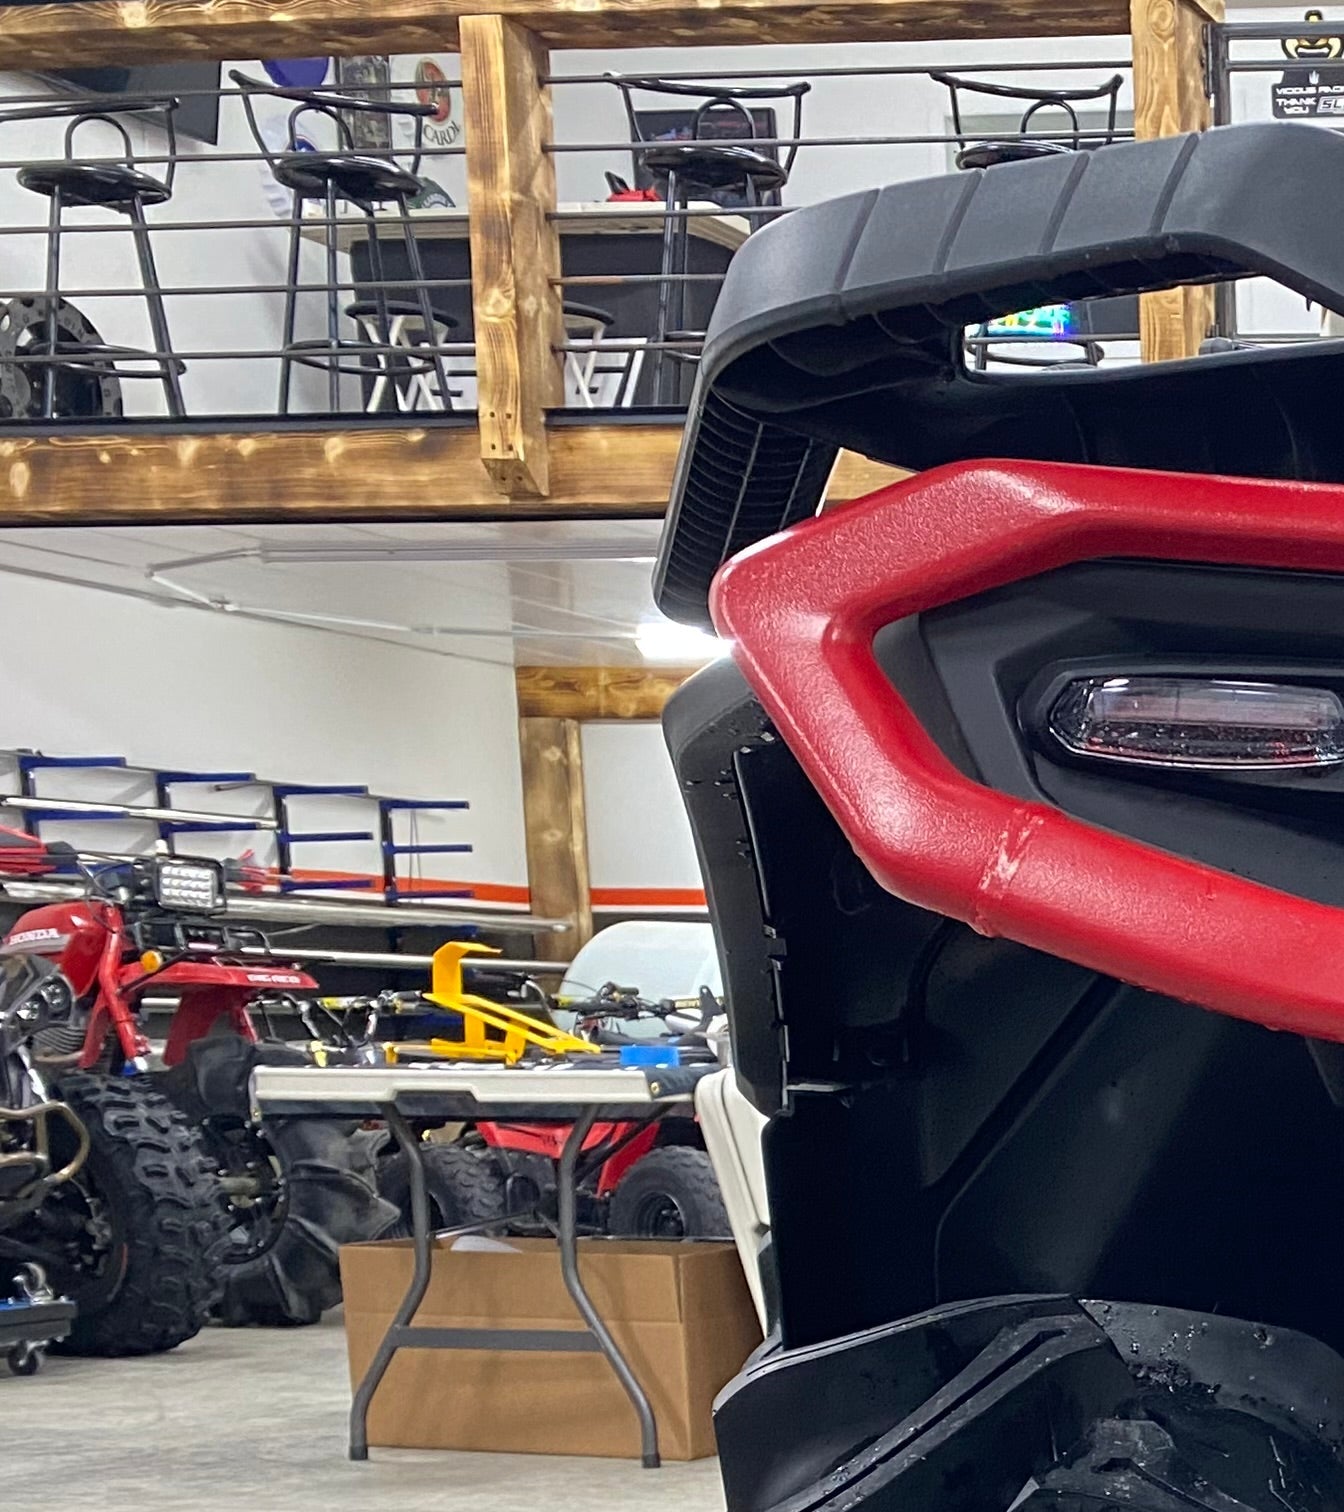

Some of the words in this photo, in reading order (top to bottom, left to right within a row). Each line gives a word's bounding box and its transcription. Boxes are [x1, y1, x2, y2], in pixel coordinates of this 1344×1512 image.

[1276, 97, 1317, 106] THANK
[1283, 106, 1310, 114] YOU
[422, 120, 461, 146] CARDI
